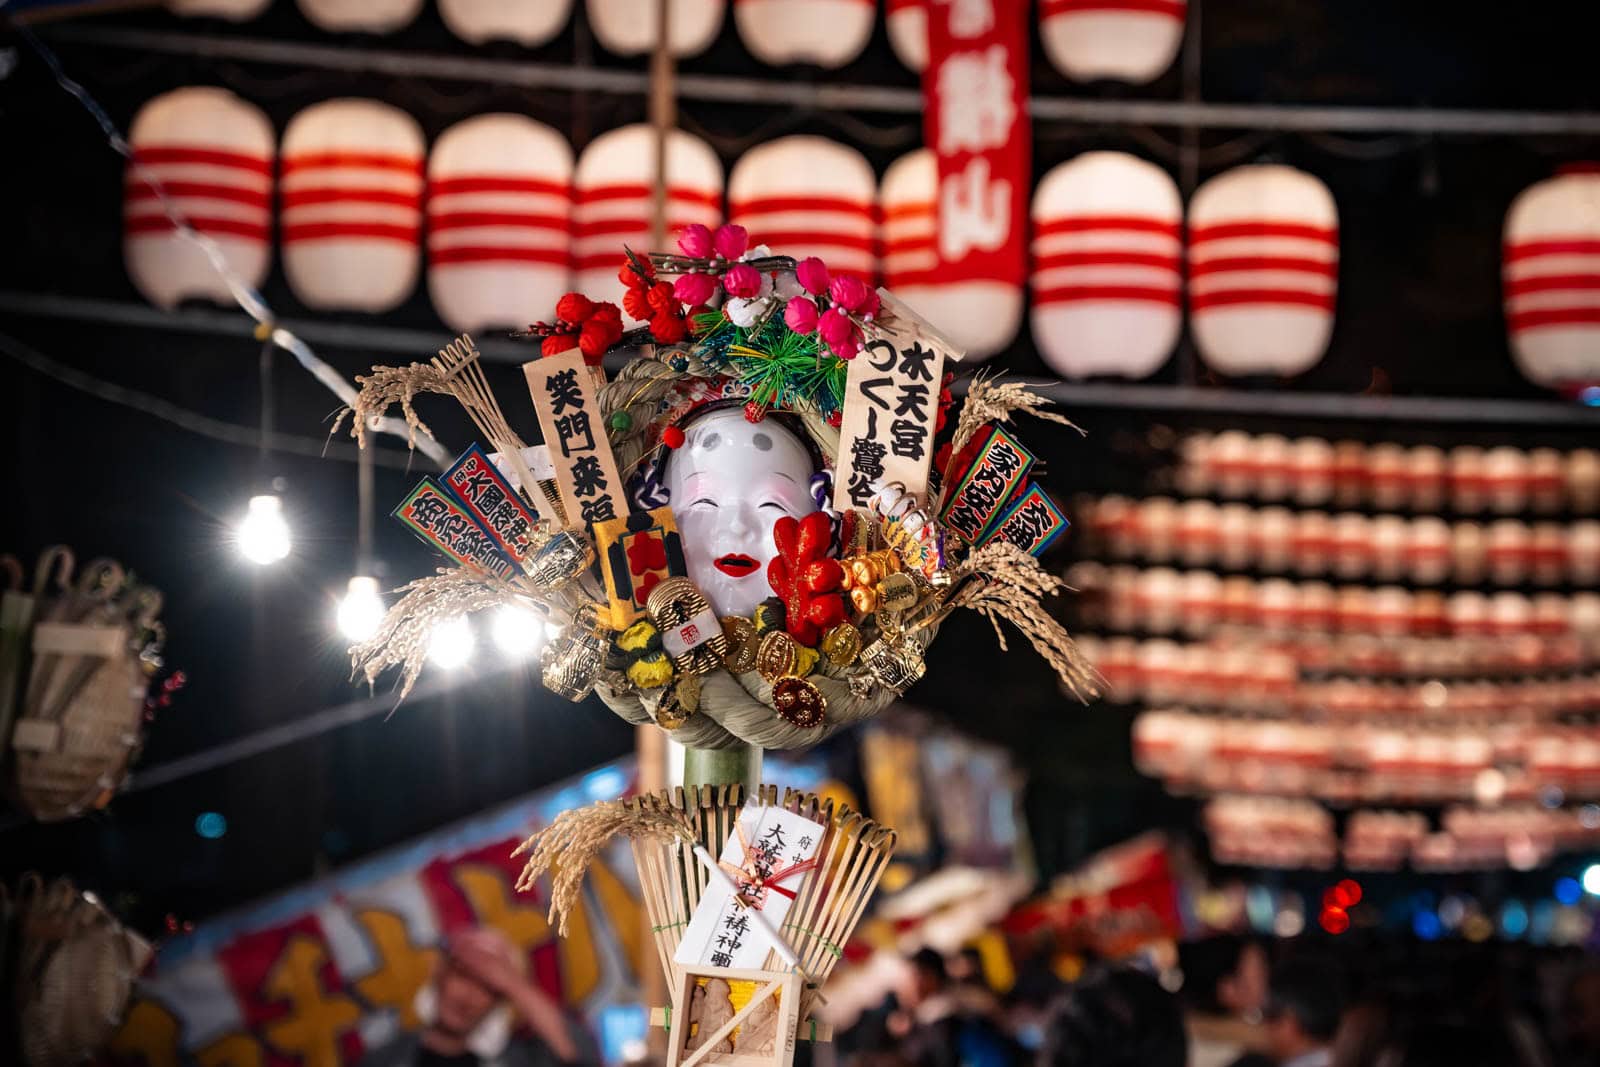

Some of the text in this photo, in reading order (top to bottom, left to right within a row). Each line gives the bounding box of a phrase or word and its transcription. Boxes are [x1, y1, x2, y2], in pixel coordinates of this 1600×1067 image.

[890, 341, 936, 462] 水天宮
[464, 471, 534, 555] 大國魂神
[947, 440, 1022, 539] 家内安全
[986, 499, 1055, 550] 交通
[792, 835, 813, 867] 府中
